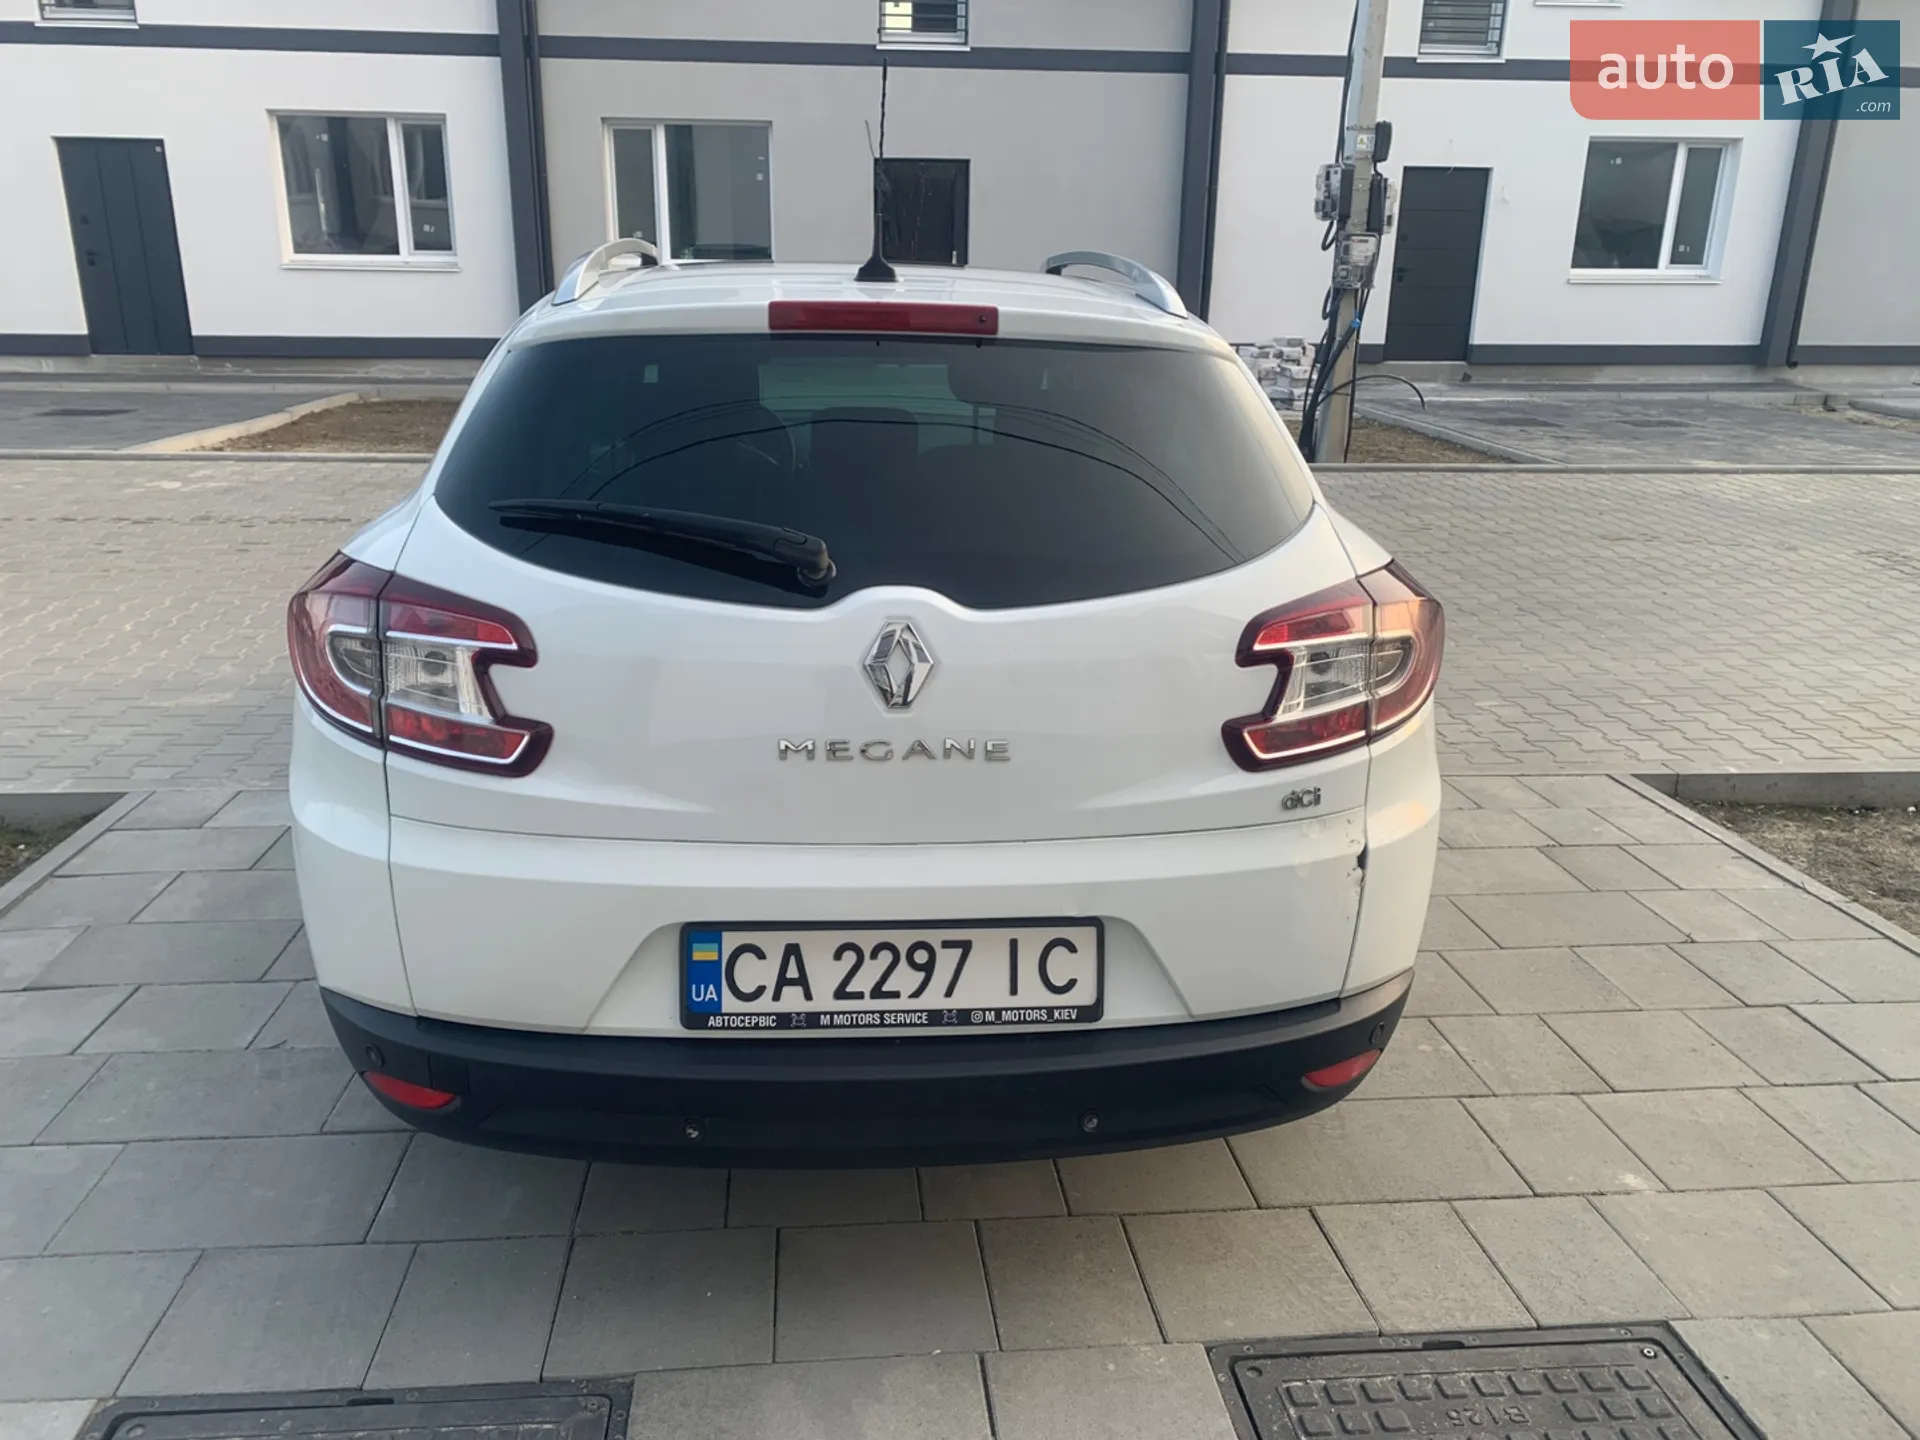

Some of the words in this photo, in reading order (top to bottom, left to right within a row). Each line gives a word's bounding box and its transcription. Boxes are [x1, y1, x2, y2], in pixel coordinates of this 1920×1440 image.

[777, 738, 1011, 761] MEGANE
[724, 942, 813, 1002] CA
[832, 939, 973, 1001] 2297
[1008, 937, 1079, 997] IC
[691, 984, 718, 1002] UA
[820, 1014, 831, 1026] M
[833, 1013, 881, 1025] MOTORS
[883, 1012, 929, 1024] SERVICE
